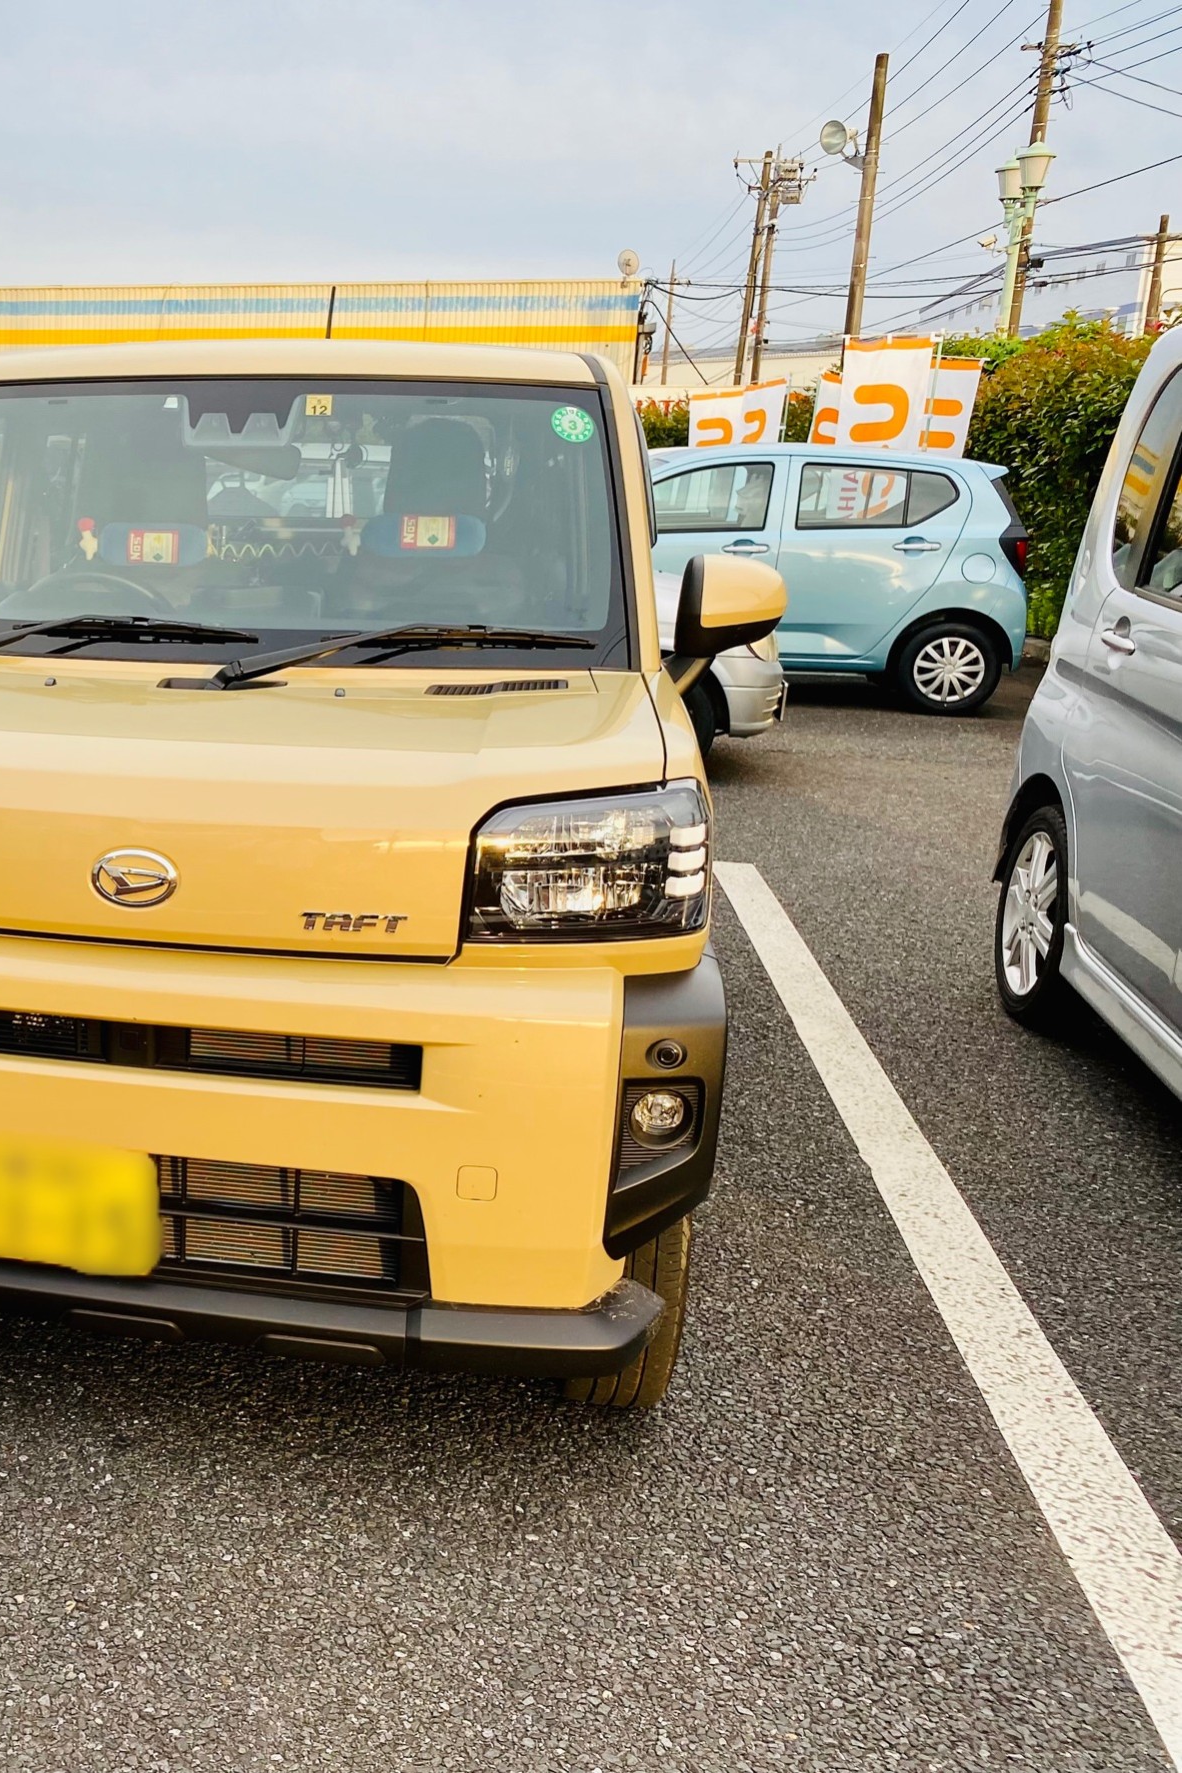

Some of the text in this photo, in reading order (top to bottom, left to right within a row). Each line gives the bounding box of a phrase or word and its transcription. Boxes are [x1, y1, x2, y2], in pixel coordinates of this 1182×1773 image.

[311, 405, 328, 415] 12
[568, 420, 578, 431] 3
[300, 911, 409, 934] TAFT
